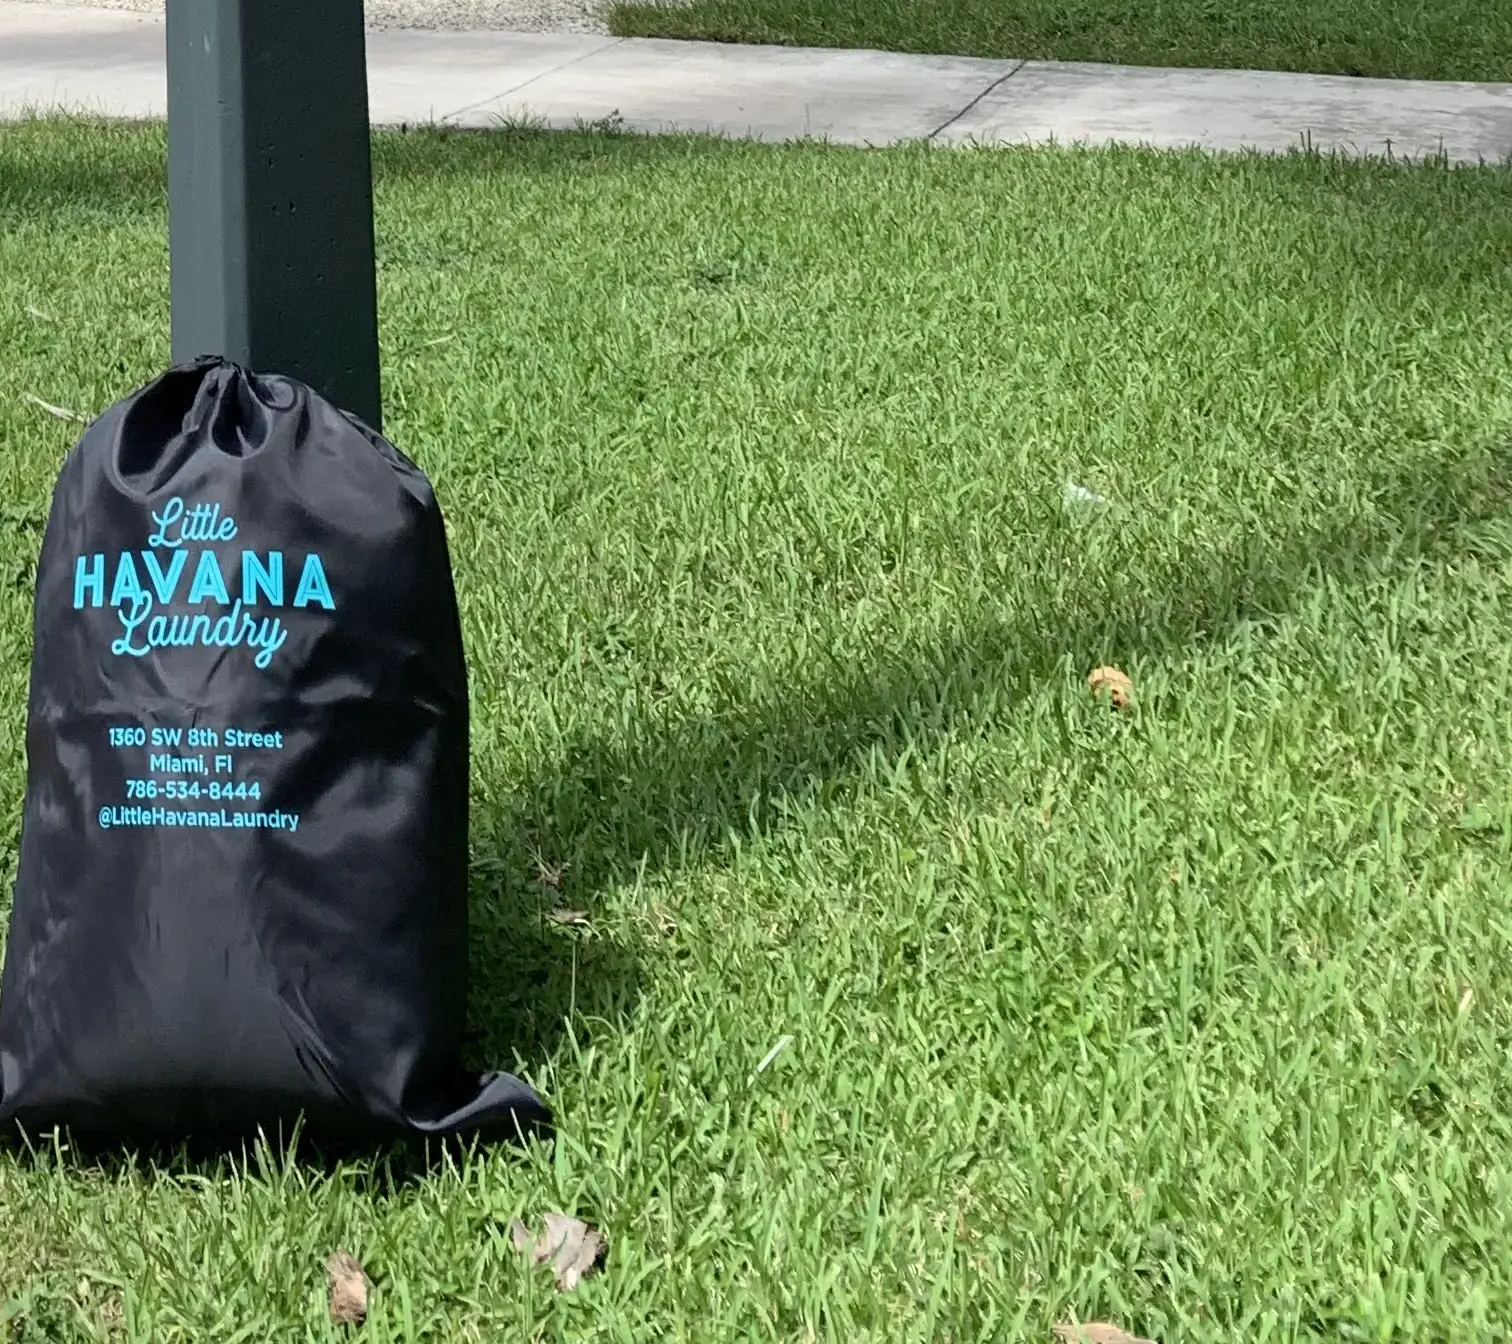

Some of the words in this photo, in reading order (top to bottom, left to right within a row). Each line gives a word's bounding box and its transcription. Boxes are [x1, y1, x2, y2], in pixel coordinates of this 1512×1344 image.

[148, 496, 238, 548] Little
[73, 550, 336, 610] HAVANA
[111, 590, 287, 668] Laundry
[108, 728, 145, 746] 1360
[151, 728, 182, 747] SW
[187, 728, 218, 747] 8th
[224, 728, 283, 749] Street
[150, 754, 208, 775] Miami,
[126, 780, 261, 800] 786-534-8444
[99, 806, 299, 833] @LittleHavanaLaundry
